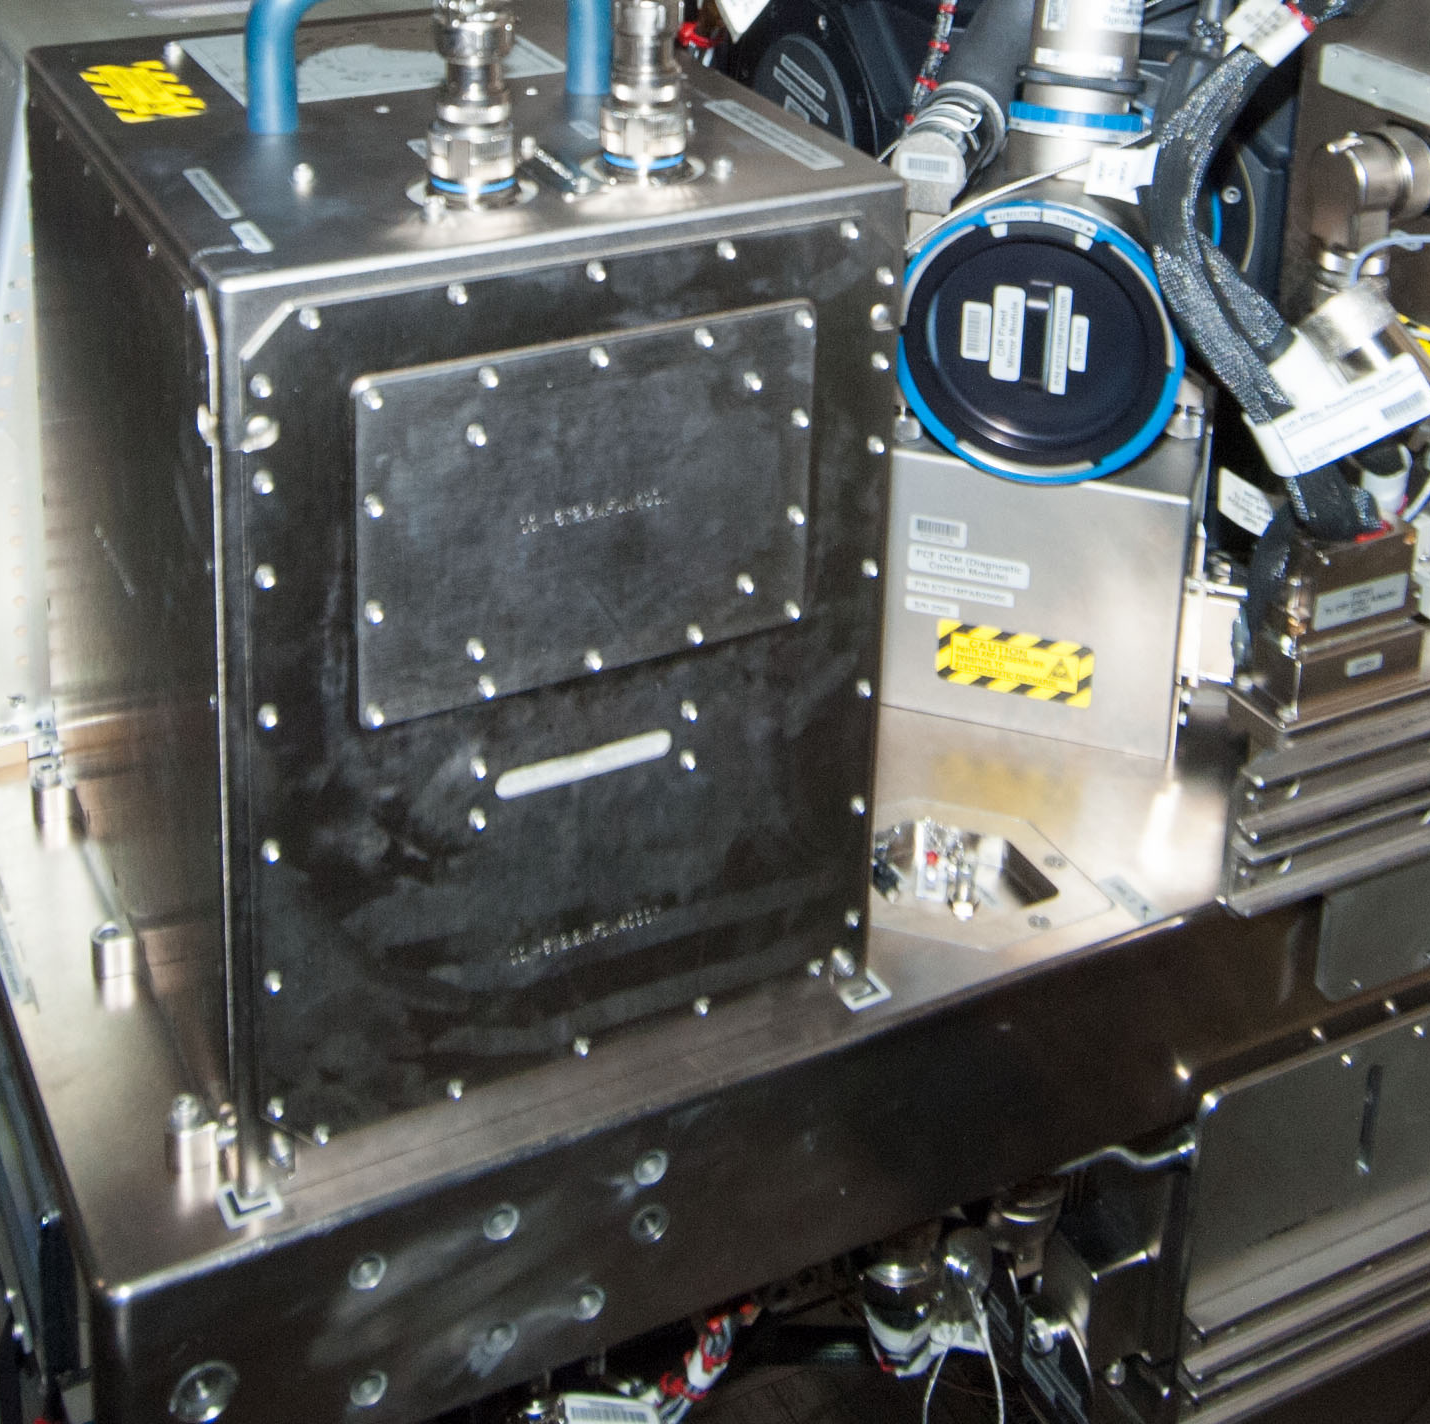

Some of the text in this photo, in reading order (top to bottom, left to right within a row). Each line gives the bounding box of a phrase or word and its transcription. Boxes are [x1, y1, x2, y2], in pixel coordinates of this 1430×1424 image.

[996, 309, 1008, 357] CIR Fixed
[1006, 301, 1020, 369] Mirror Module
[916, 548, 1023, 575] FCF DCM (Diagnostic
[928, 561, 1009, 583] Control Module)
[956, 645, 1044, 668] PARTS AND ASSEMBLIES
[969, 639, 1028, 658] CAUTION
[955, 654, 1005, 670] SENSITIVE TO
[955, 661, 1057, 689] ELECTROSTATIC DISCHARGE
